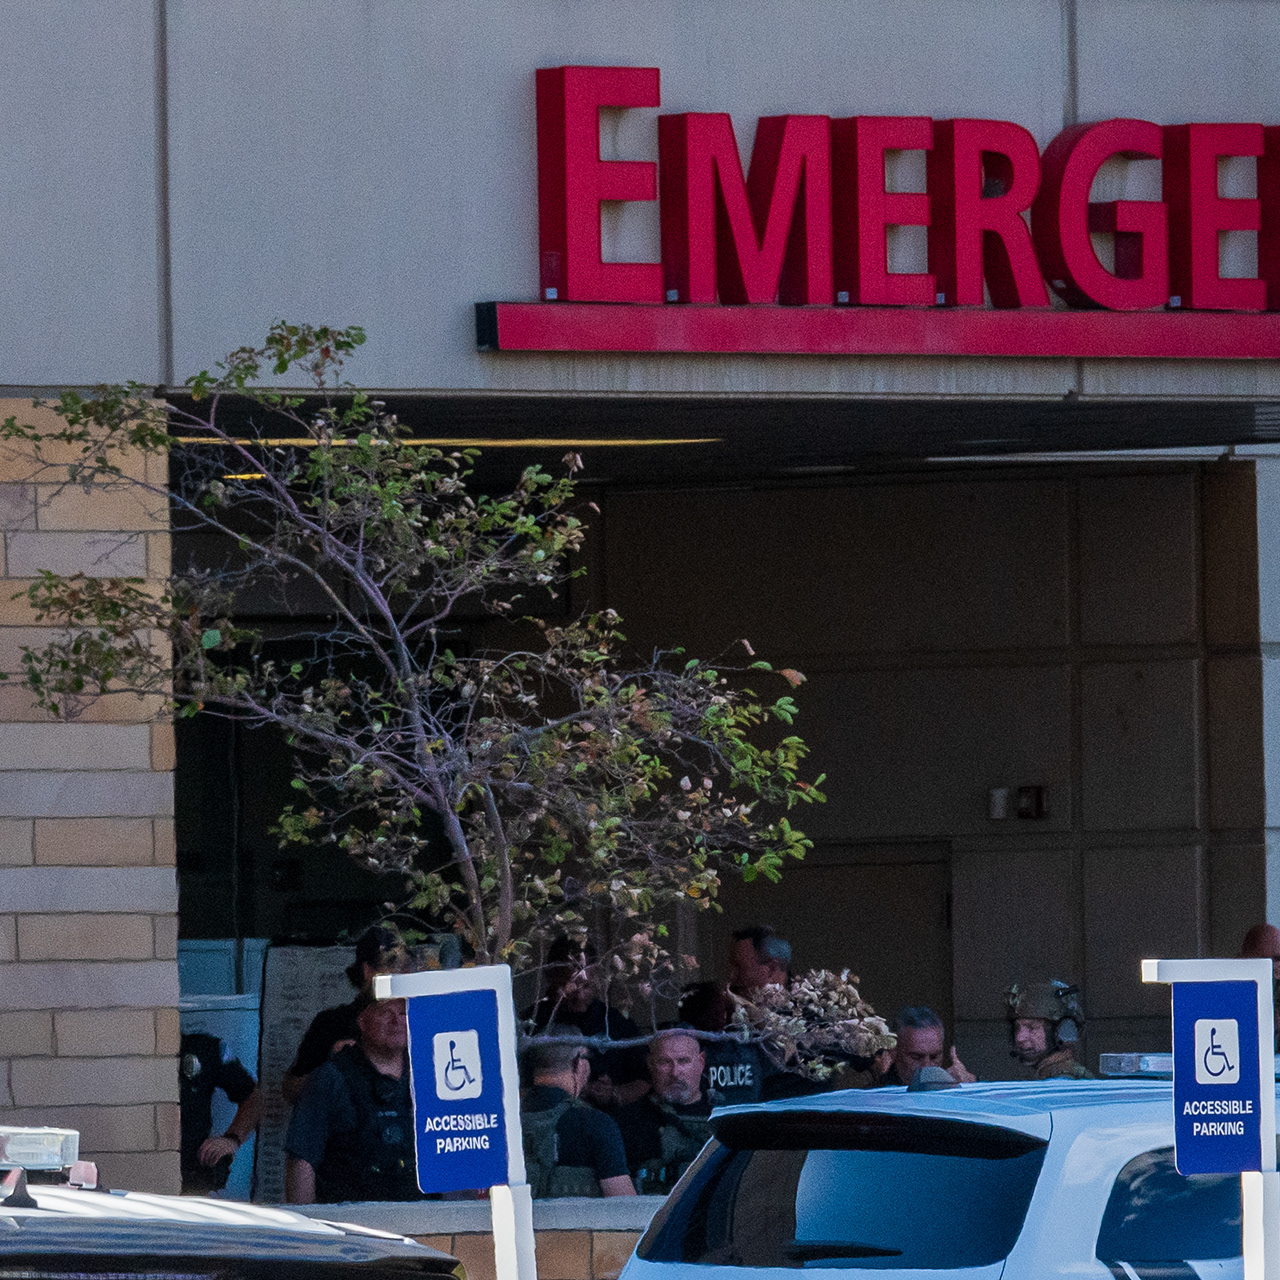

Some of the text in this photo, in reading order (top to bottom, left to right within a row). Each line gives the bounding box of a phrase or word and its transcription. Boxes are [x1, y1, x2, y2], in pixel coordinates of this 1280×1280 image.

[709, 1063, 754, 1088] POLICE
[1182, 1100, 1254, 1116] ACCESSIBLE
[424, 1113, 499, 1133] ACCESSIBLE
[1193, 1121, 1245, 1137] PARKING
[436, 1135, 490, 1154] PARKING
